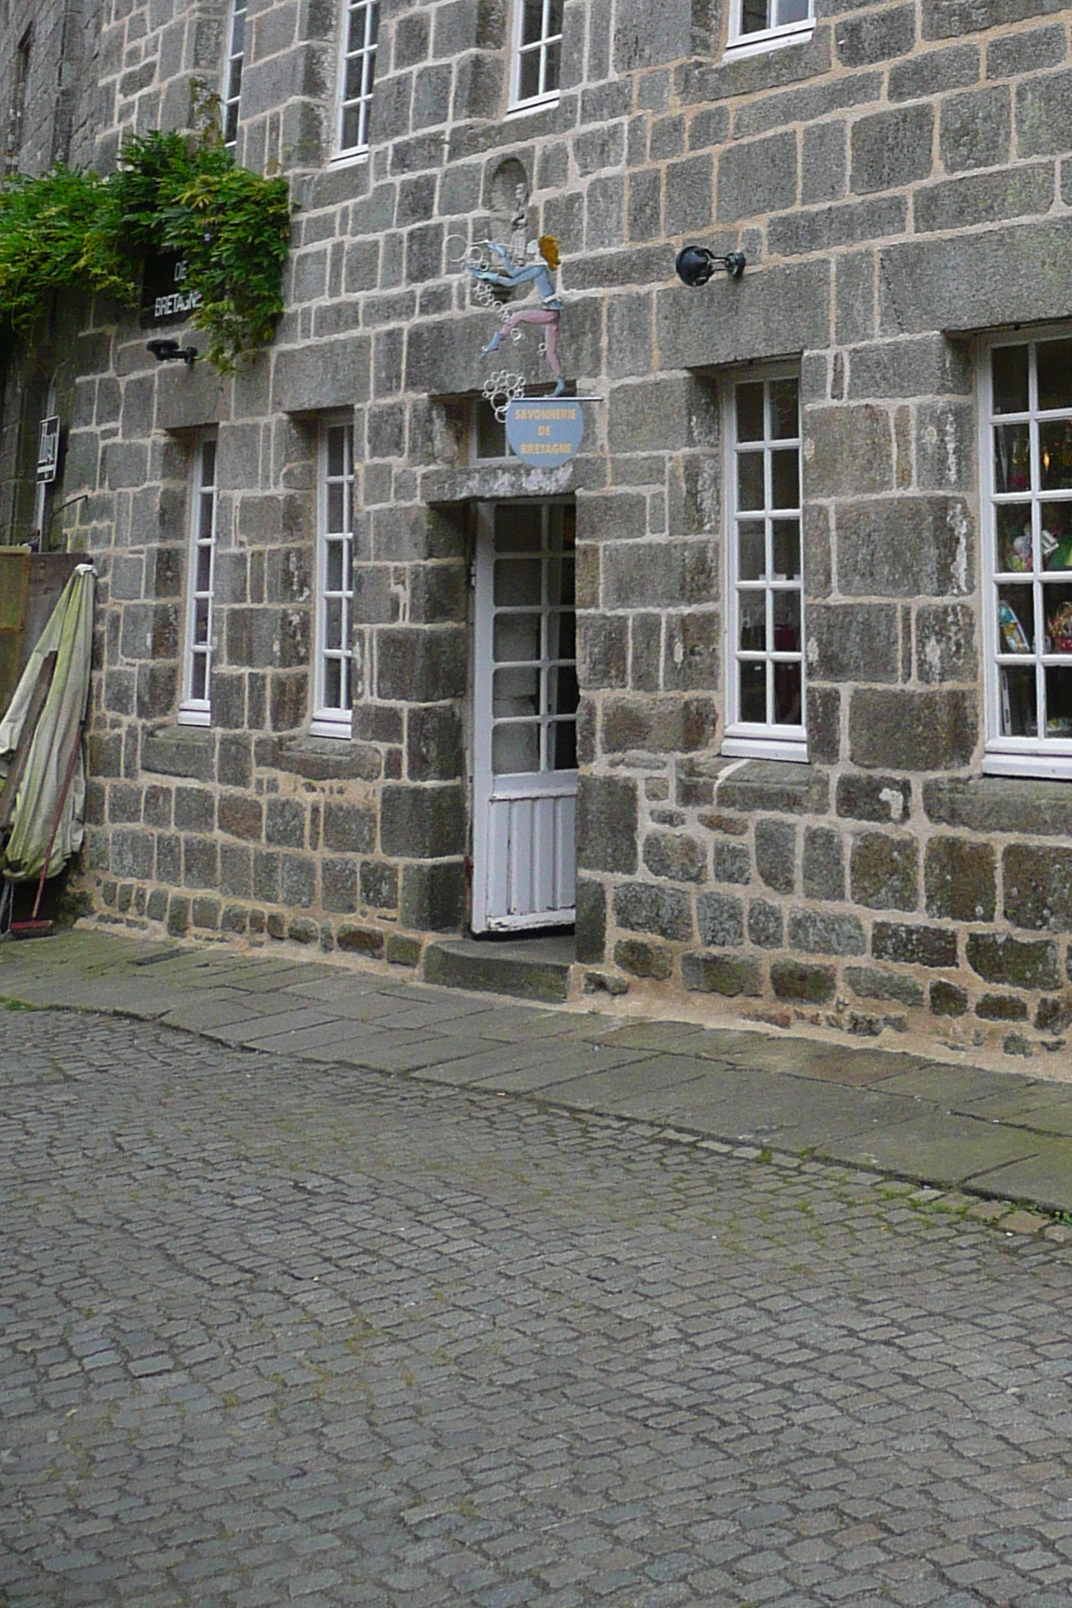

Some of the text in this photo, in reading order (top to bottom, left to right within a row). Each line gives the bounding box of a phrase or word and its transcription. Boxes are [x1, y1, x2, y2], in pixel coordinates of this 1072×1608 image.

[174, 260, 188, 282] DE
[514, 408, 576, 421] SAVONNERIE
[537, 425, 552, 437] DE
[520, 443, 572, 455] BRETAGNE
